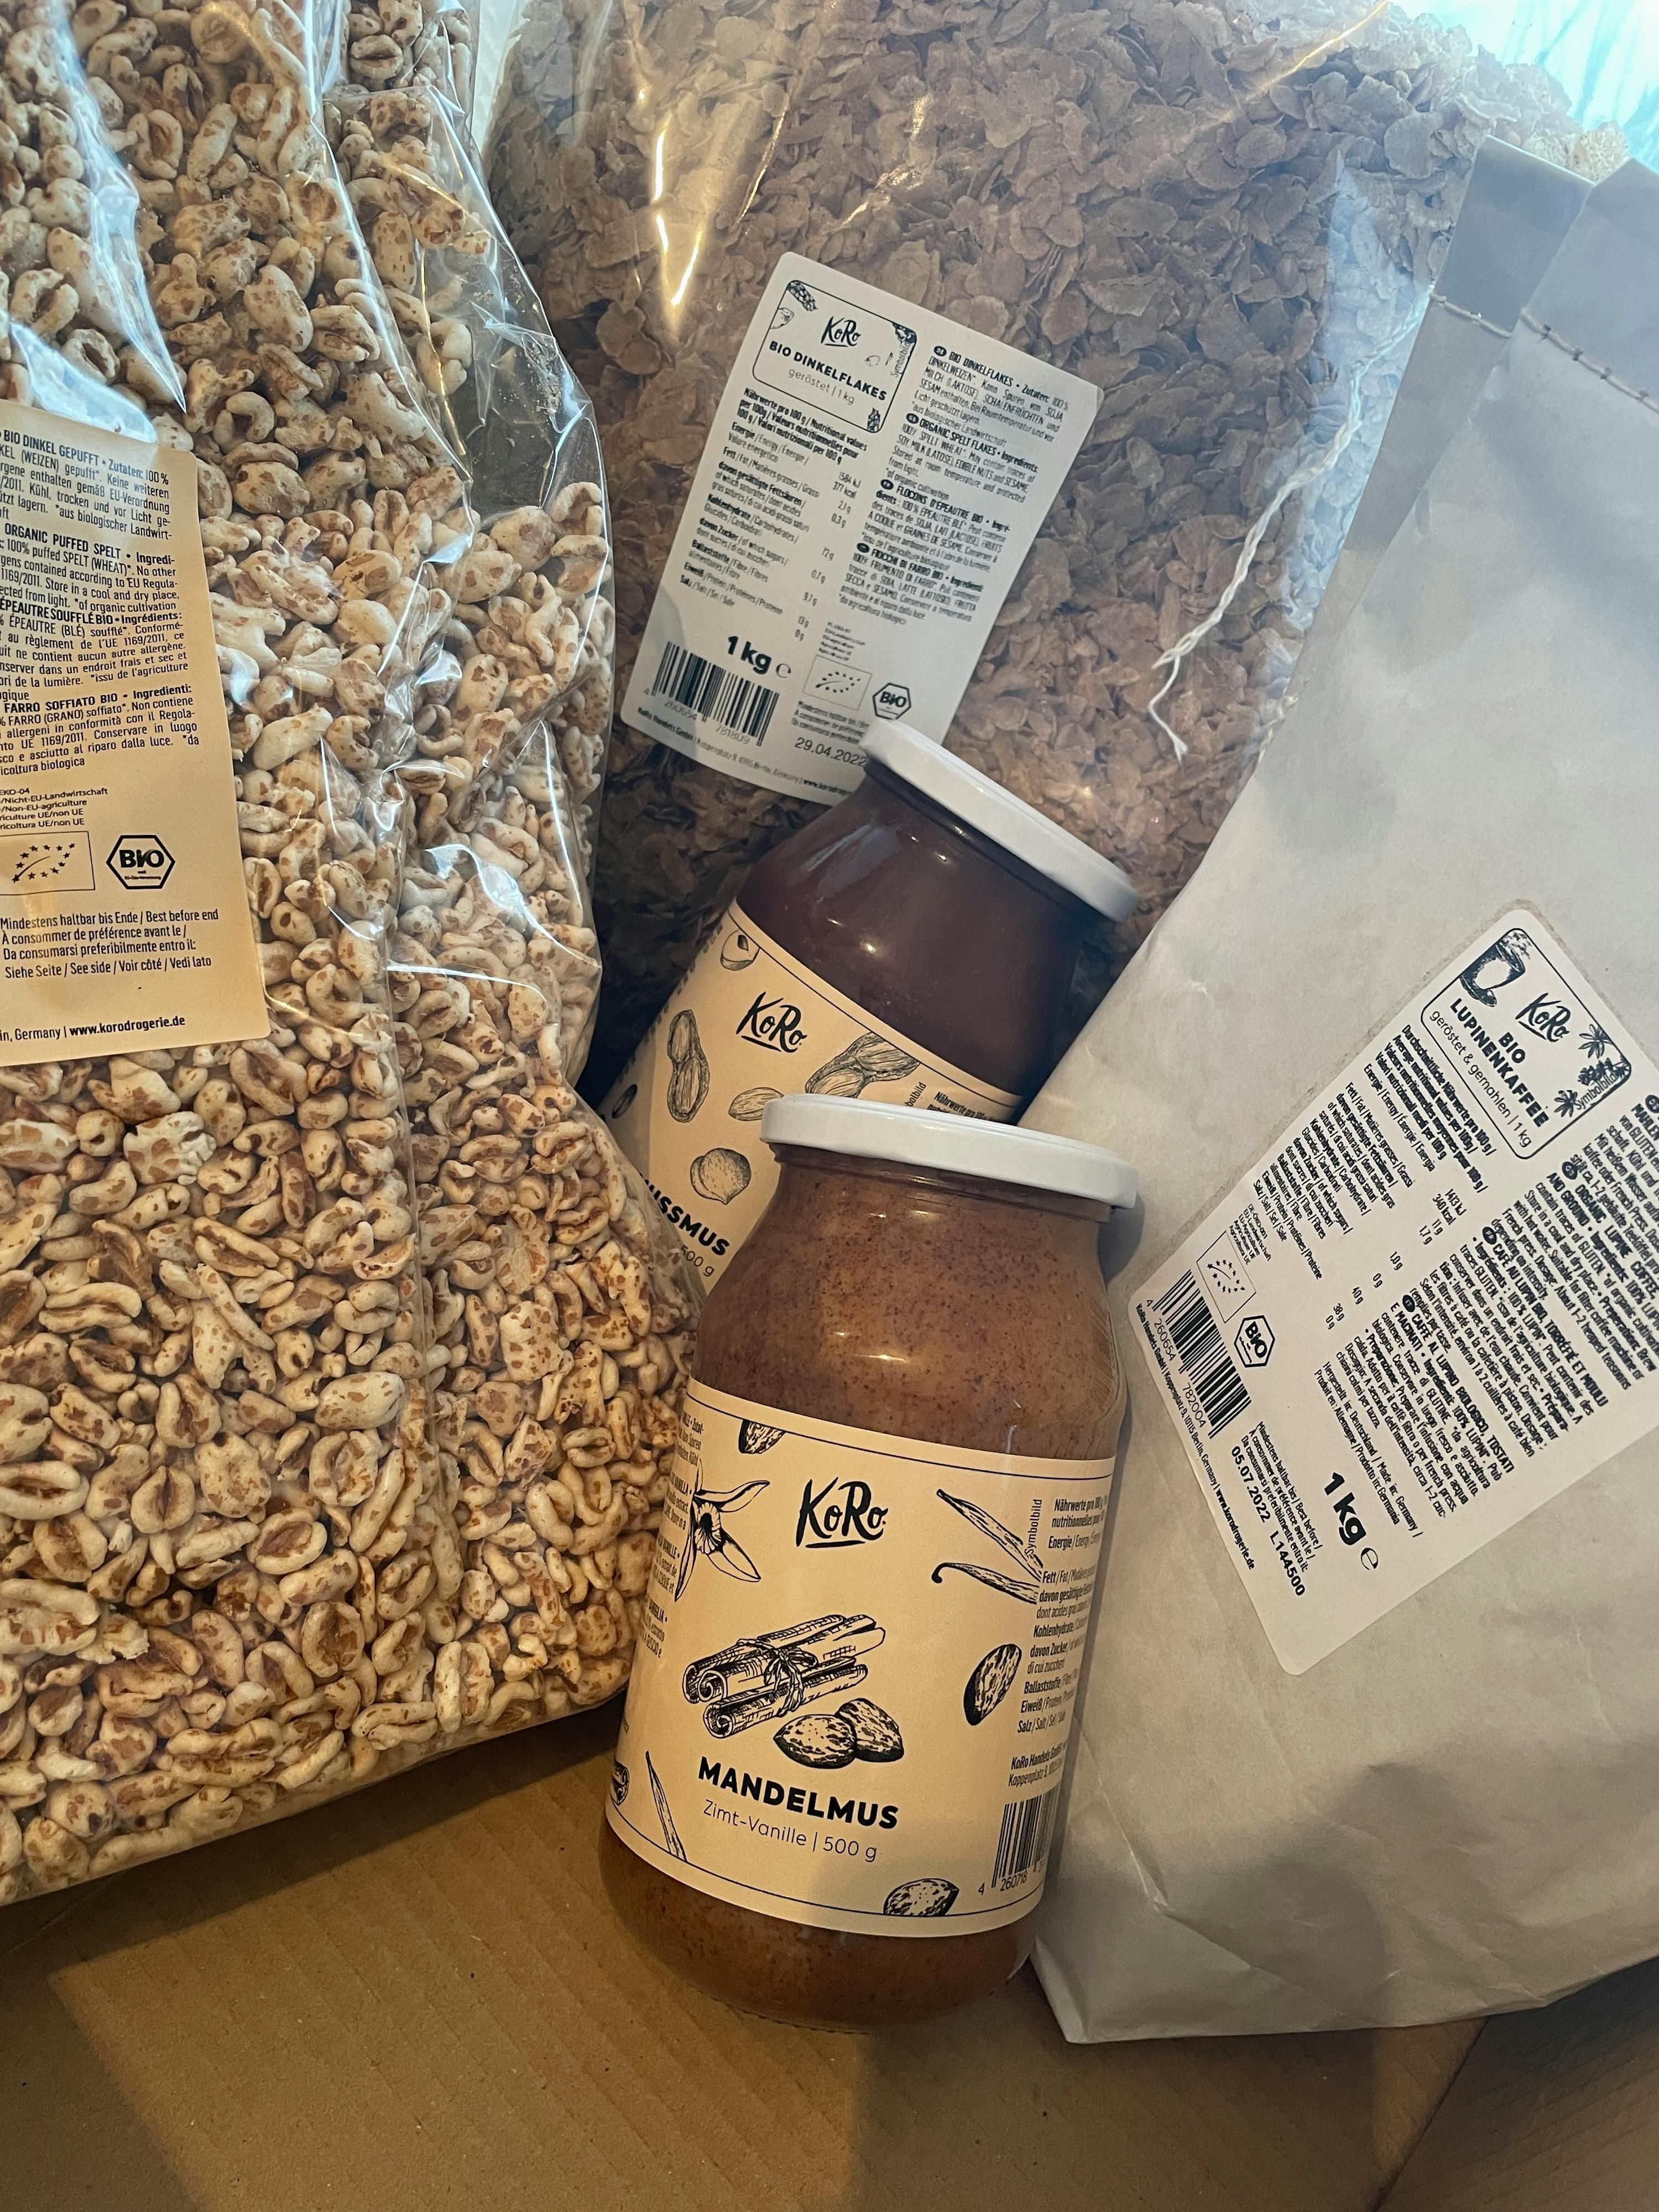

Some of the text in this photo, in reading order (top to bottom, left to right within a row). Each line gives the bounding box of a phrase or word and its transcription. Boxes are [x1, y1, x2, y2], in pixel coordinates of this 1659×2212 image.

[820, 316, 862, 347] KoRo
[769, 340, 887, 401] BIO DINKELFLAKES
[788, 369, 830, 393] geröstet
[838, 389, 842, 398] 1
[843, 391, 855, 406] kg
[3, 429, 169, 485] BIO DINKEL GEPUFFT Zutaten: 100 %
[4, 523, 175, 566] ORGANIC PUFFED SPELT Ingredi-
[727, 635, 773, 675] 1 kg
[4, 684, 192, 713] FARRO SOFFIATO BIO Ingredienti:
[879, 691, 907, 708] BIO
[795, 737, 867, 768] 29.04.2022
[119, 849, 164, 868] BIO
[0, 917, 58, 930] Mindestens
[60, 912, 96, 926] haltbar
[98, 912, 113, 924] bis
[114, 911, 138, 924] Ende
[145, 911, 168, 922] Best
[169, 909, 200, 922] before
[202, 909, 219, 920] end
[2, 930, 10, 945] À
[12, 931, 71, 945] consommer
[74, 928, 86, 941] de
[88, 926, 142, 943] préférence
[144, 926, 171, 937] avant
[172, 925, 181, 936] le
[3, 938, 196, 960] Da consumarsi preferibilmente entro il:
[5, 966, 34, 979] Siehe
[35, 964, 62, 977] Seite
[70, 962, 89, 975] See
[91, 961, 111, 974] side
[118, 959, 139, 972] Voir
[140, 958, 162, 971] côté
[169, 956, 191, 969] Vedi
[192, 956, 212, 967] lato
[14, 1028, 61, 1041] Germany
[69, 1015, 185, 1036] www.korodrogerie.de
[736, 992, 807, 1053] KoRo
[1429, 1011, 1467, 1056] geröstet
[1515, 993, 1571, 1043] KoRo
[1450, 998, 1550, 1128] LUPINENKAFFEE
[1463, 1053, 1474, 1066] &
[1498, 1032, 1526, 1064] BIO
[1468, 1065, 1511, 1118] gemahlen
[1514, 1122, 1523, 1131] 1
[1517, 1129, 1532, 1148] kg
[1432, 1193, 1457, 1225] 340 kcal
[1444, 1188, 1467, 1216] 1413 kJ
[681, 1245, 714, 1277] 500 g
[1244, 1321, 1272, 1359] BIO
[1154, 1318, 1176, 1361] 260654
[1182, 1382, 1207, 1428] 782004
[1254, 1421, 1279, 1463] Mindestens
[1275, 1460, 1292, 1488] haltbar
[1288, 1485, 1297, 1500] bis
[1295, 1501, 1308, 1521] Best
[1303, 1518, 1319, 1546] before
[795, 1478, 889, 1548] KoRo
[1054, 1499, 1086, 1512] Nährwerte
[1232, 1446, 1305, 1596] 05.07.2022 L144500
[1324, 1472, 1366, 1546] 1 kg
[1024, 1499, 1042, 1555] Symbolbild
[1048, 1536, 1072, 1551] Energie
[1042, 1571, 1056, 1584] Fett
[1039, 1589, 1058, 1603] davon
[1030, 1645, 1050, 1658] davon
[1020, 1699, 1042, 1713] Eiweiß
[1018, 1720, 1032, 1733] Salz
[1011, 1756, 1029, 1770] KoRo
[698, 1757, 899, 1829] MANDELMUS
[703, 1799, 807, 1846] Zimt-Vanille
[823, 1836, 859, 1856] 500
[865, 1847, 877, 1863] g
[978, 1870, 1027, 1895] 4 260718
